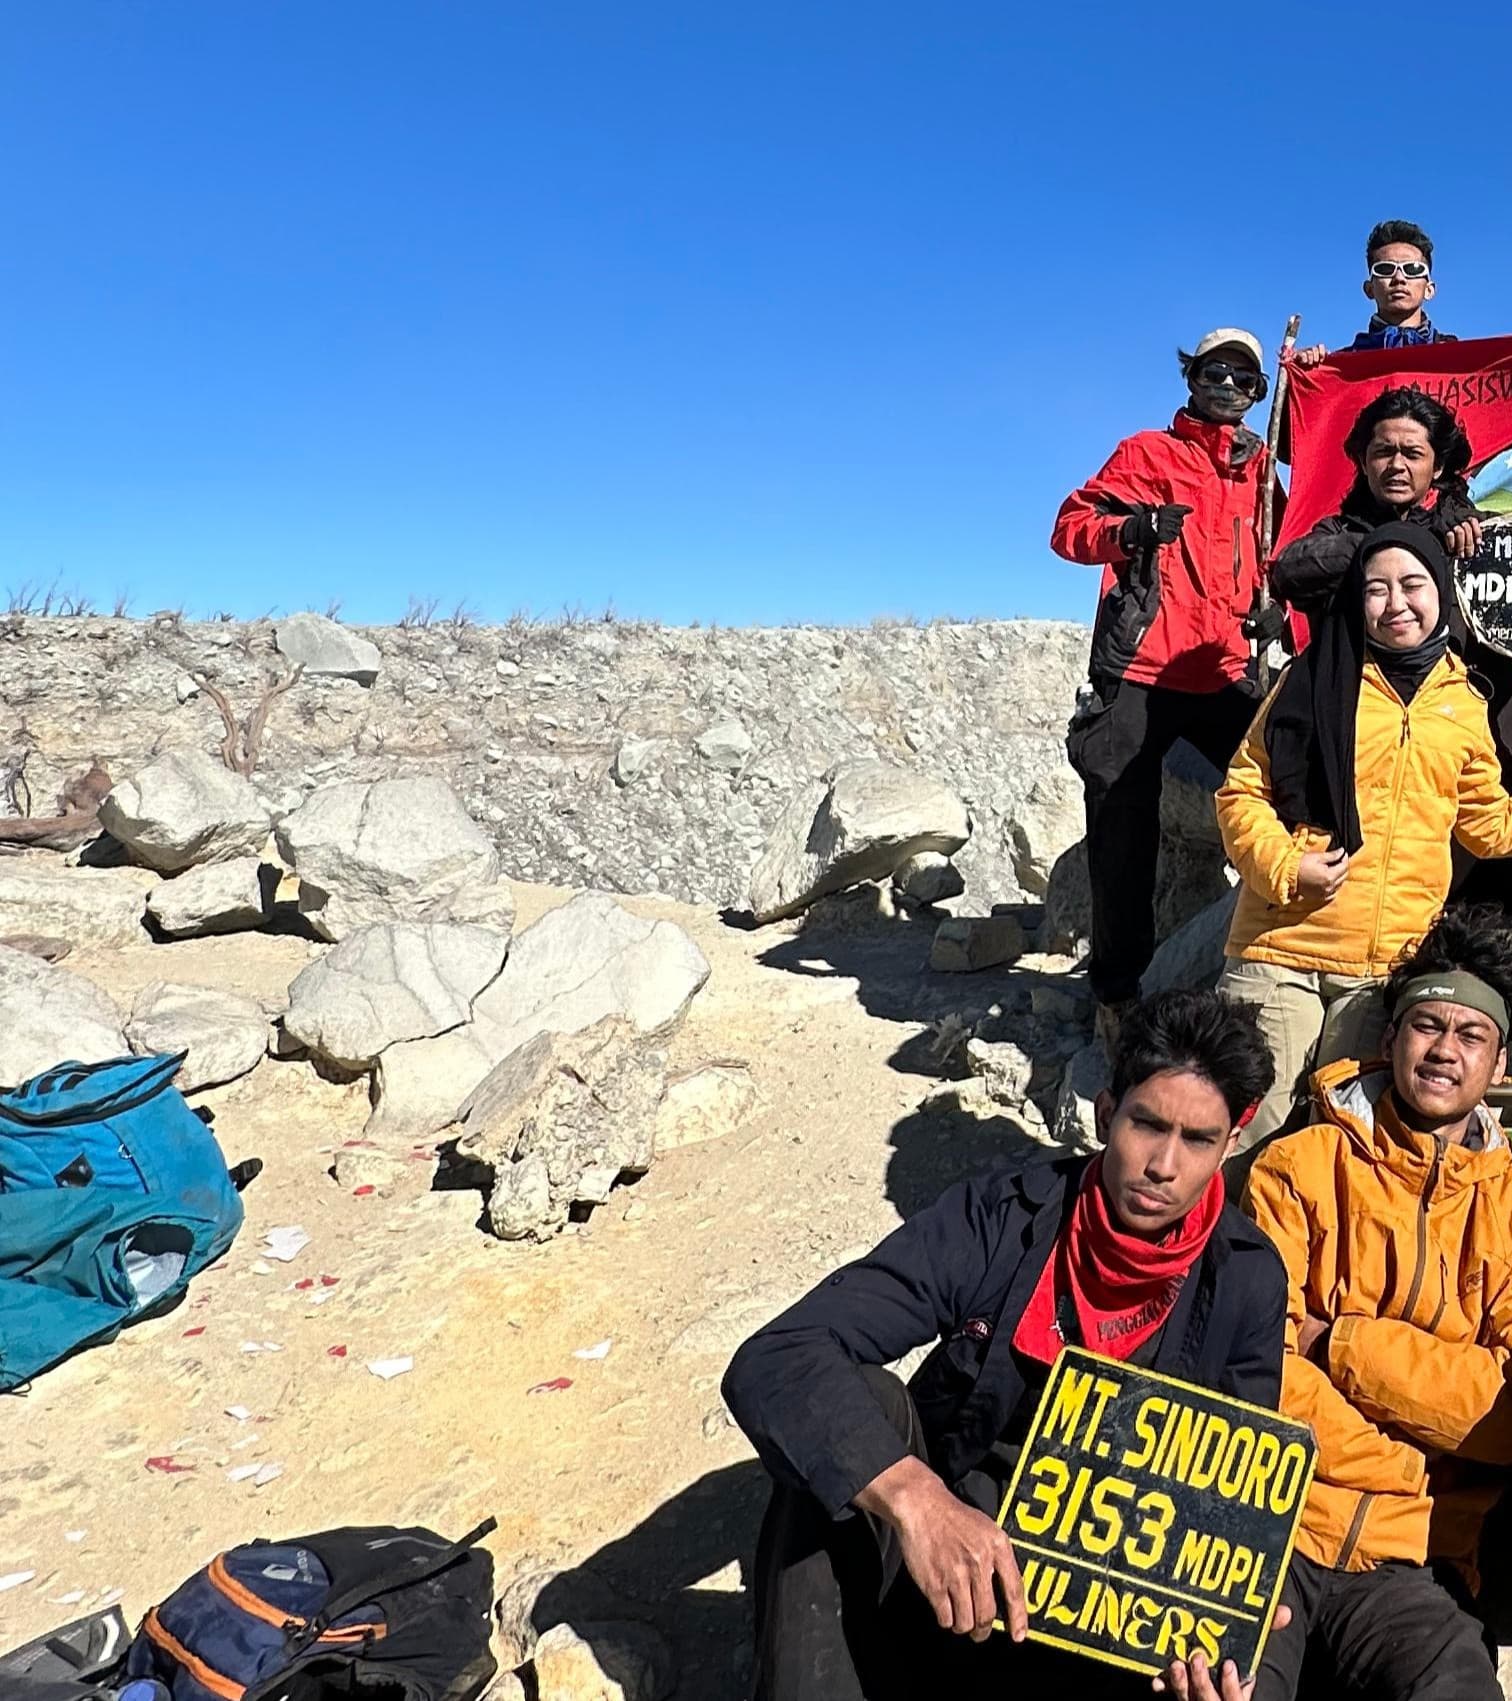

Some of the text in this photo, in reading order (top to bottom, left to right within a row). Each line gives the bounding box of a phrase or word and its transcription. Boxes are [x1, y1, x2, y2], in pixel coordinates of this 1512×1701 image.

[1043, 1367, 1307, 1515] MT. SINDORO
[1015, 1455, 1266, 1609] 3153 MDPL
